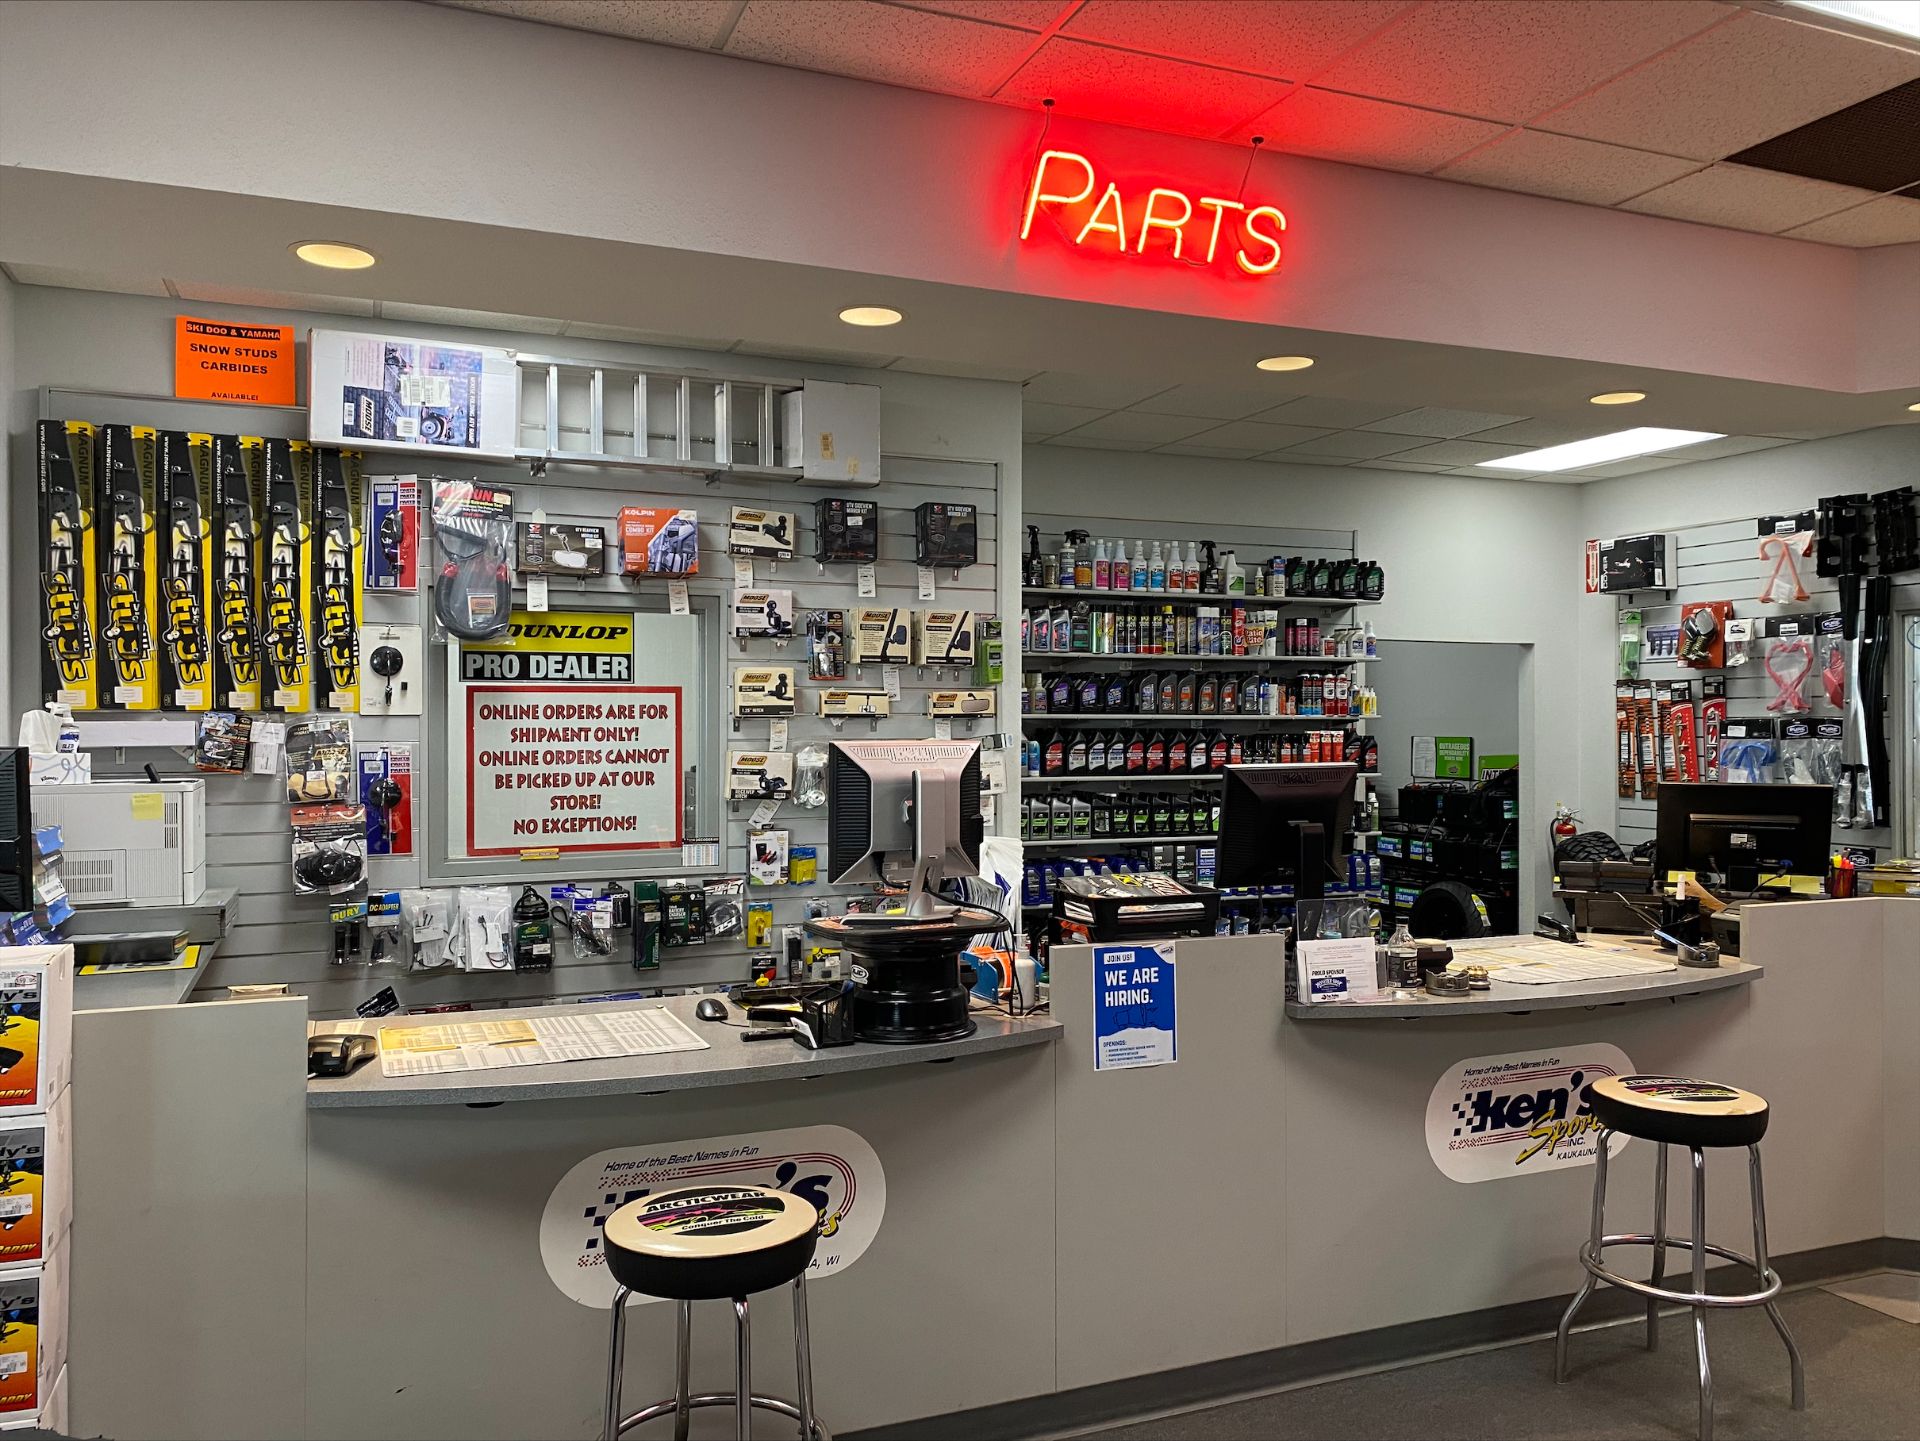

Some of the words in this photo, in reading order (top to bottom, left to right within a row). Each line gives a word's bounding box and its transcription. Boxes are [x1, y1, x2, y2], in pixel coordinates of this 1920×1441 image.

[1020, 150, 1286, 273] PARTS
[186, 323, 203, 332] SKI
[206, 326, 227, 335] DOO
[230, 328, 237, 336] &
[240, 329, 280, 339] YAMAHA
[190, 343, 230, 355] SNOW
[234, 347, 278, 359] STUDS
[200, 360, 268, 374] CARBIDES
[211, 392, 259, 401] AVAILABLE!
[364, 398, 373, 434] MOOSE
[468, 417, 477, 429] ATV
[468, 429, 477, 444] RAMP
[78, 426, 89, 486] MAGNUM
[143, 432, 154, 489] MAGNUM
[199, 439, 210, 495] MAGNUM
[250, 441, 261, 497] MAGNUM
[300, 446, 310, 501] MAGNUM
[350, 451, 360, 505] MAGNUM
[624, 509, 656, 517] KOLPIN
[1600, 555, 1608, 589] COVER
[506, 624, 628, 640] DUNLOP
[466, 654, 520, 679] PRO
[529, 655, 629, 680] DEALER
[745, 673, 770, 681] MOOSE
[479, 704, 540, 721] ONLINE
[542, 704, 603, 720] ORDERS
[605, 704, 636, 720] ARE
[639, 704, 669, 720] FOR
[510, 727, 592, 743] SHIPMENT
[593, 726, 640, 742] ONLY!
[478, 750, 539, 767] ONLINE
[542, 749, 603, 766] ORDERS
[605, 748, 670, 764] CANNOT
[740, 756, 766, 764] MOOSE
[494, 773, 513, 789] BE
[516, 772, 572, 789] PICKED
[575, 771, 597, 787] UP
[598, 771, 620, 787] AT
[621, 770, 656, 786] OUR
[550, 794, 602, 811] STORE!
[513, 818, 539, 835] NO
[542, 815, 638, 834] EXCEPTIONS!
[332, 905, 360, 921] OURY
[369, 904, 379, 912] DC
[379, 903, 400, 912] ADAPTER
[1106, 954, 1121, 963] JOIN
[1122, 953, 1133, 961] US!
[1105, 969, 1127, 987] WE
[1132, 967, 1159, 985] ARE
[1105, 988, 1154, 1007] HIRING.
[1463, 1068, 1484, 1077] Home
[1484, 1065, 1491, 1074] of
[1503, 1063, 1520, 1072] Best
[1519, 1060, 1541, 1070] Names
[1541, 1059, 1548, 1067] in
[1547, 1057, 1561, 1066] Fun
[1567, 1137, 1586, 1147] INC.
[604, 1161, 635, 1173] Home
[636, 1158, 649, 1169] of
[650, 1156, 666, 1167] the
[667, 1154, 695, 1165] Best
[693, 1150, 729, 1162] Names
[729, 1148, 739, 1157] in
[739, 1145, 759, 1156] Fun
[646, 1191, 766, 1213] ARCTICWEAR
[681, 1219, 723, 1231] Conquer
[725, 1216, 741, 1225] The
[741, 1214, 764, 1223] Cold
[826, 1255, 840, 1266] WI
